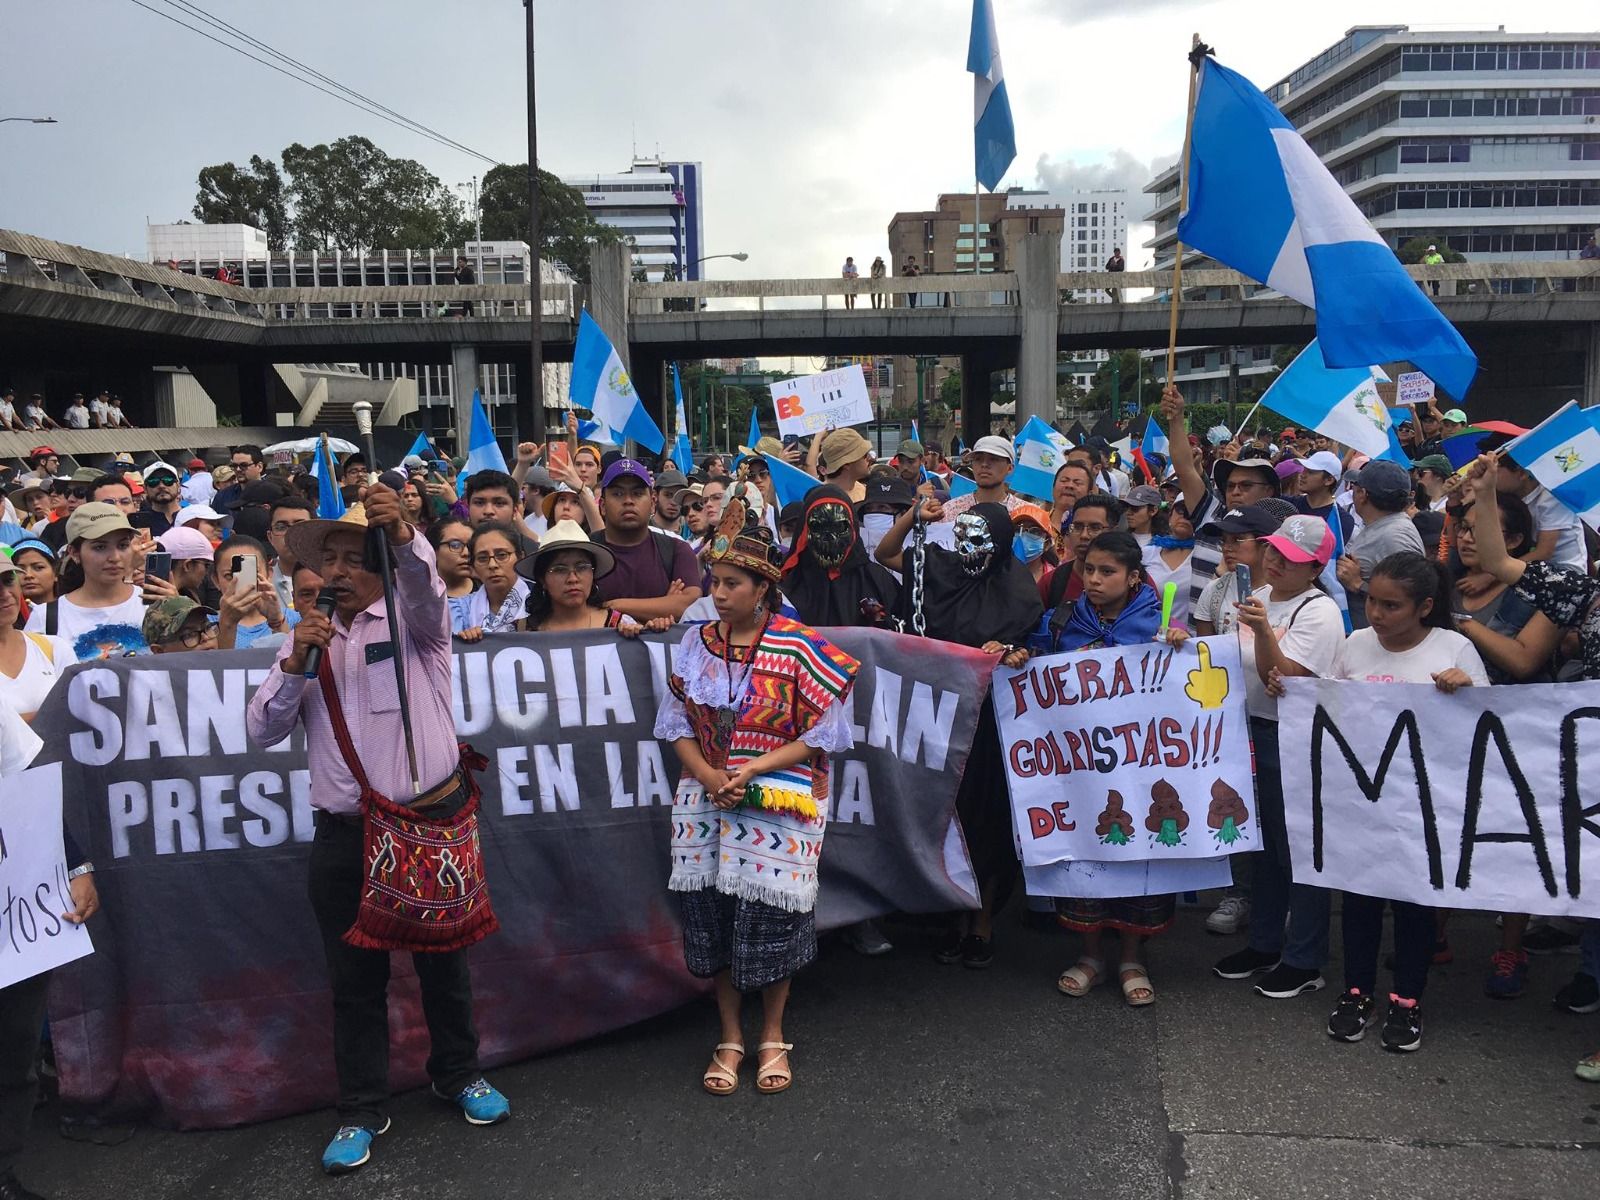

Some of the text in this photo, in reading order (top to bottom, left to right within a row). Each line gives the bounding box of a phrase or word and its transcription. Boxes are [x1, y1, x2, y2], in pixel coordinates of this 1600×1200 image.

[776, 394, 805, 420] ES
[1401, 379, 1431, 389] GOLPISTA
[67, 668, 308, 766] SAN
[451, 643, 636, 737] UCIA
[1009, 711, 1224, 778] GOLPISTAS!!!
[108, 740, 673, 859] PRESE EN LA
[1027, 801, 1076, 840] DE
